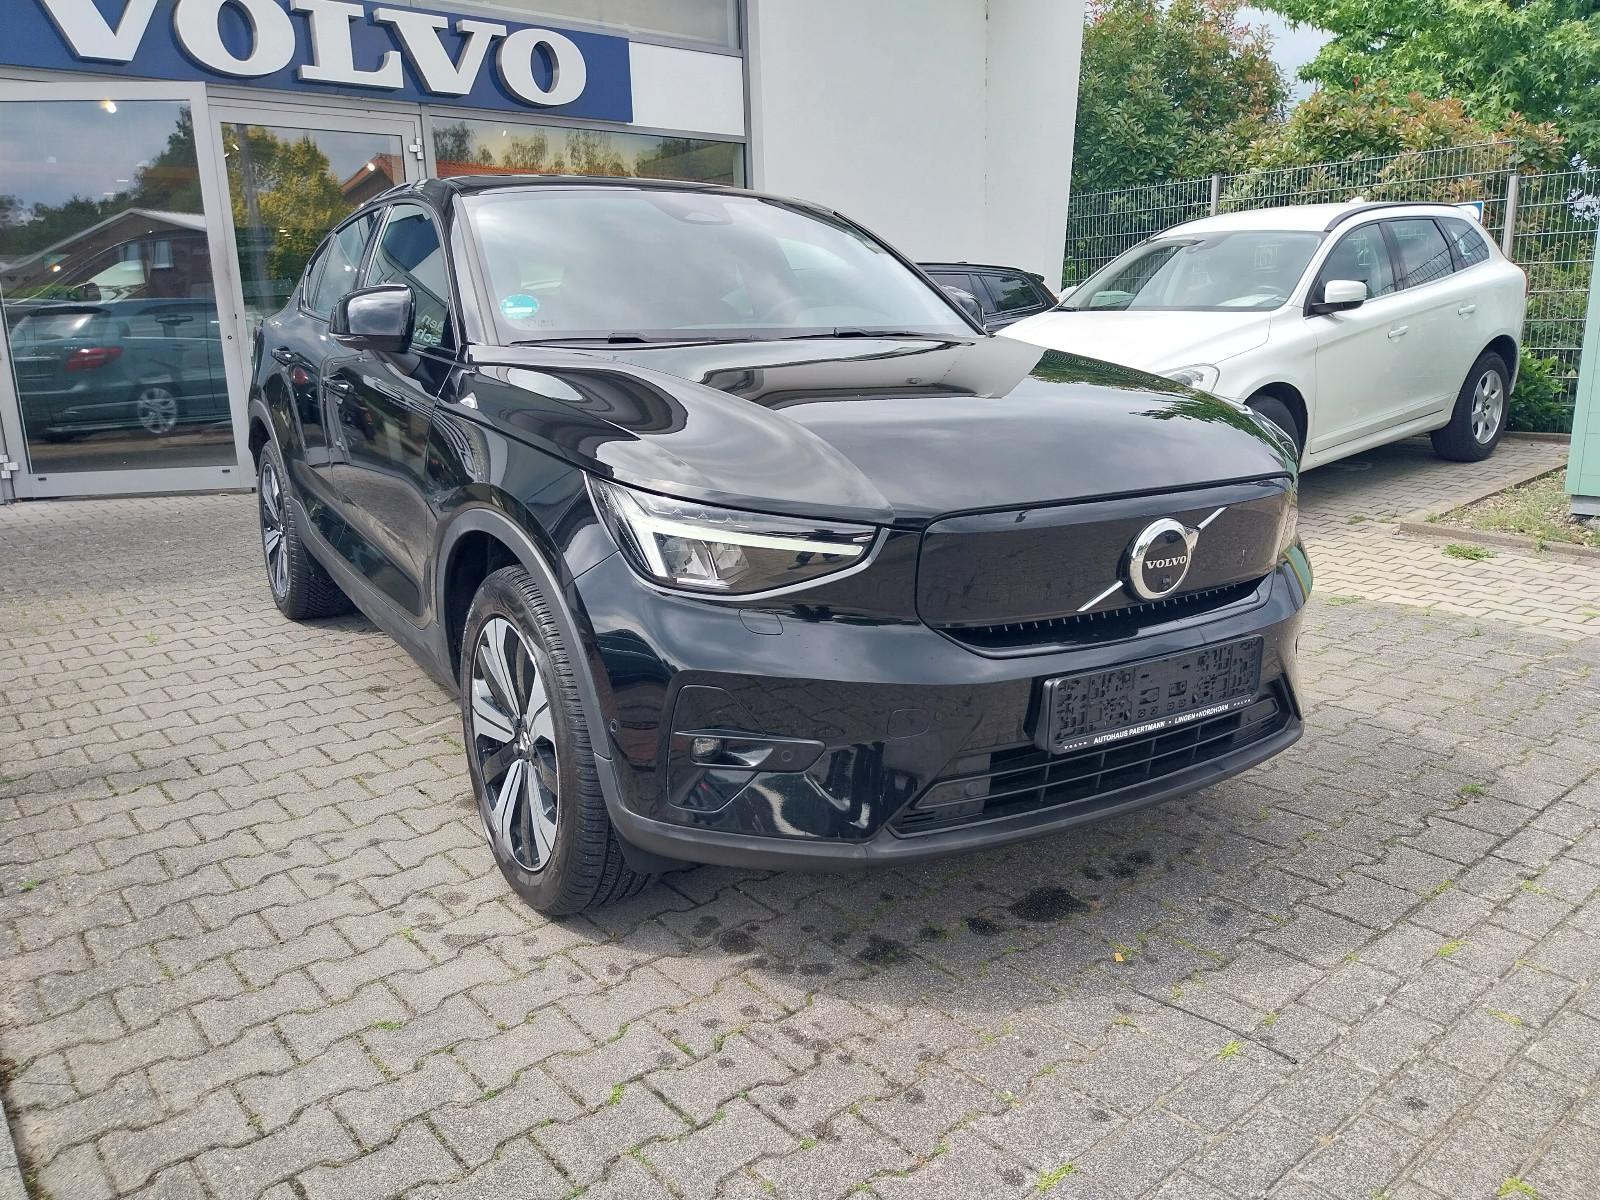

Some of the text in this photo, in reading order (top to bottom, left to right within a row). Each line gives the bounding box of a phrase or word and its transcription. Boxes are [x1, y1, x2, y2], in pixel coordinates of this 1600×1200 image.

[41, 0, 587, 106] VOLVO
[1145, 555, 1187, 569] VOLVO
[1093, 730, 1129, 744] AUTOHAUS
[1129, 721, 1166, 736] PAERTMANN
